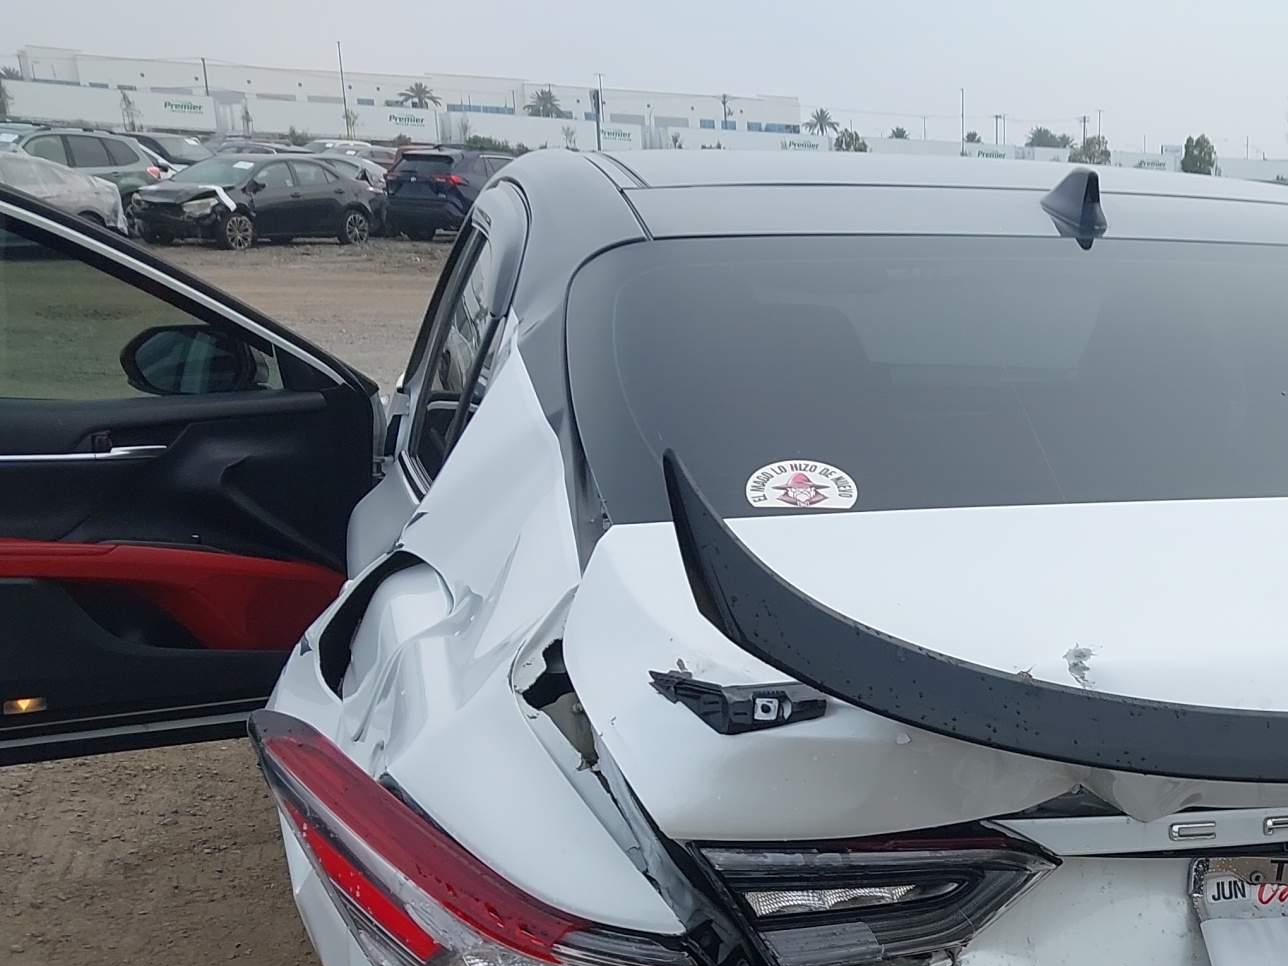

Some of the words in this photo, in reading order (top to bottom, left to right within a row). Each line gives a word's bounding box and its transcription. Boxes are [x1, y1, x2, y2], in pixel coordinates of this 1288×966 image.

[164, 101, 202, 110] Premier
[389, 114, 424, 123] Premier
[769, 465, 787, 475] LO
[789, 463, 818, 472] HIZO
[819, 467, 837, 478] DE
[1211, 880, 1246, 902] JUN
